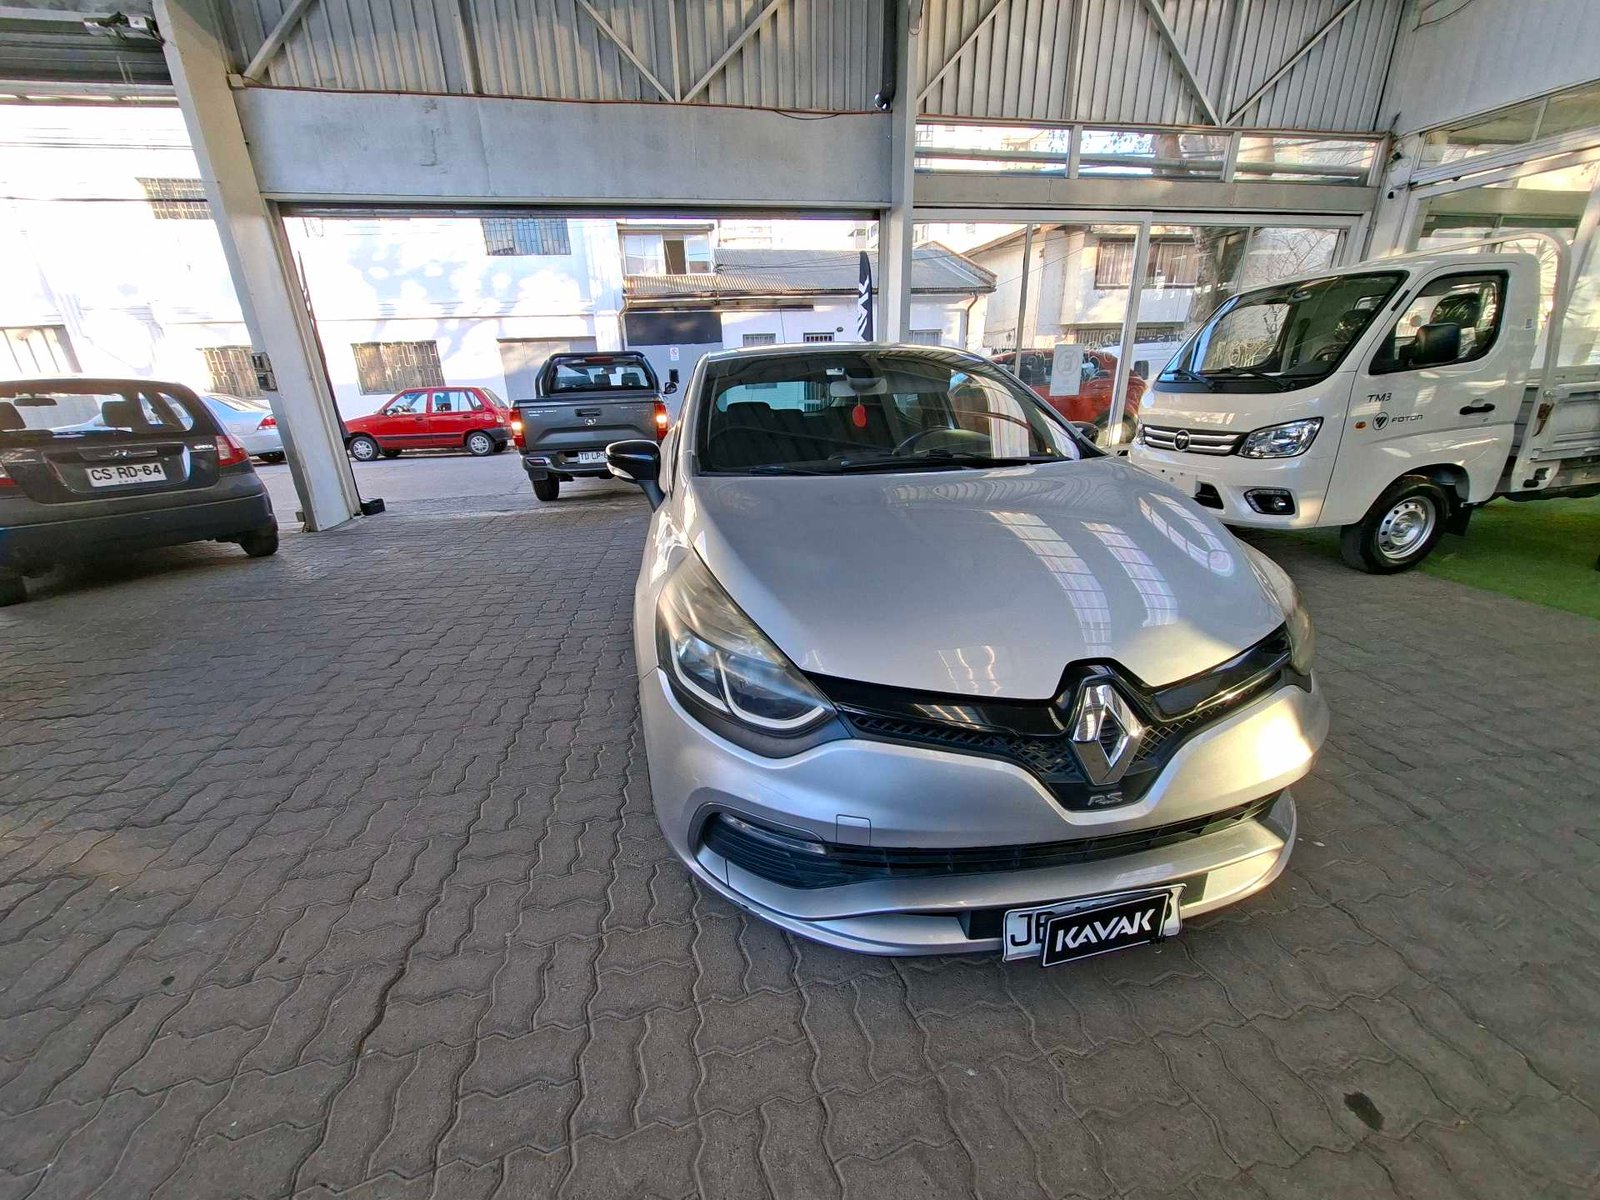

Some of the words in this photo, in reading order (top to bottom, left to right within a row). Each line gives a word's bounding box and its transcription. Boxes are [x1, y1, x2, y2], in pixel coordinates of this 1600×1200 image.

[1368, 392, 1392, 402] TM3
[1391, 414, 1424, 423] FOTON
[1055, 908, 1156, 952] KAVAK
